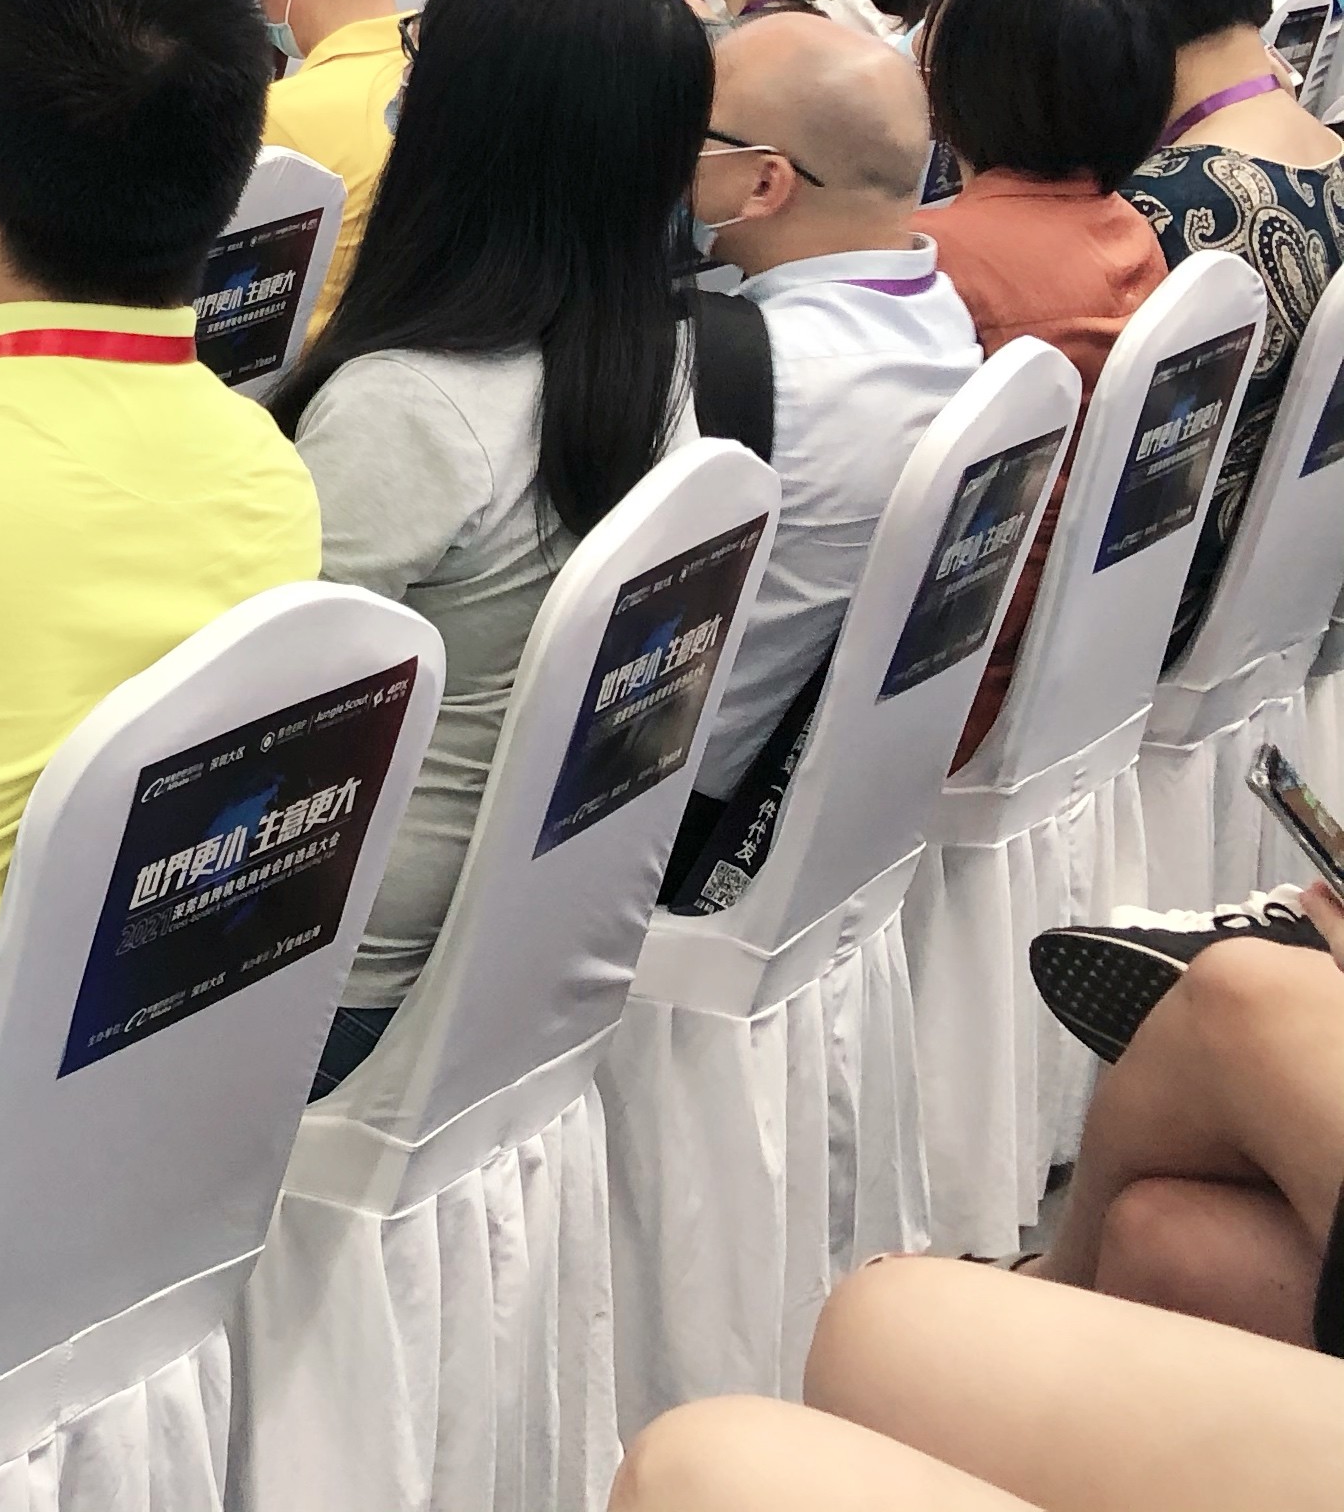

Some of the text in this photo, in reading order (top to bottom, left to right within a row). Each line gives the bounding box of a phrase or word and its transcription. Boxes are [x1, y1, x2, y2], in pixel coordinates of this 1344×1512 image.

[244, 269, 297, 306] 生意更大
[595, 646, 663, 713] 世界更小
[129, 776, 362, 911] 世界更小 生意更大
